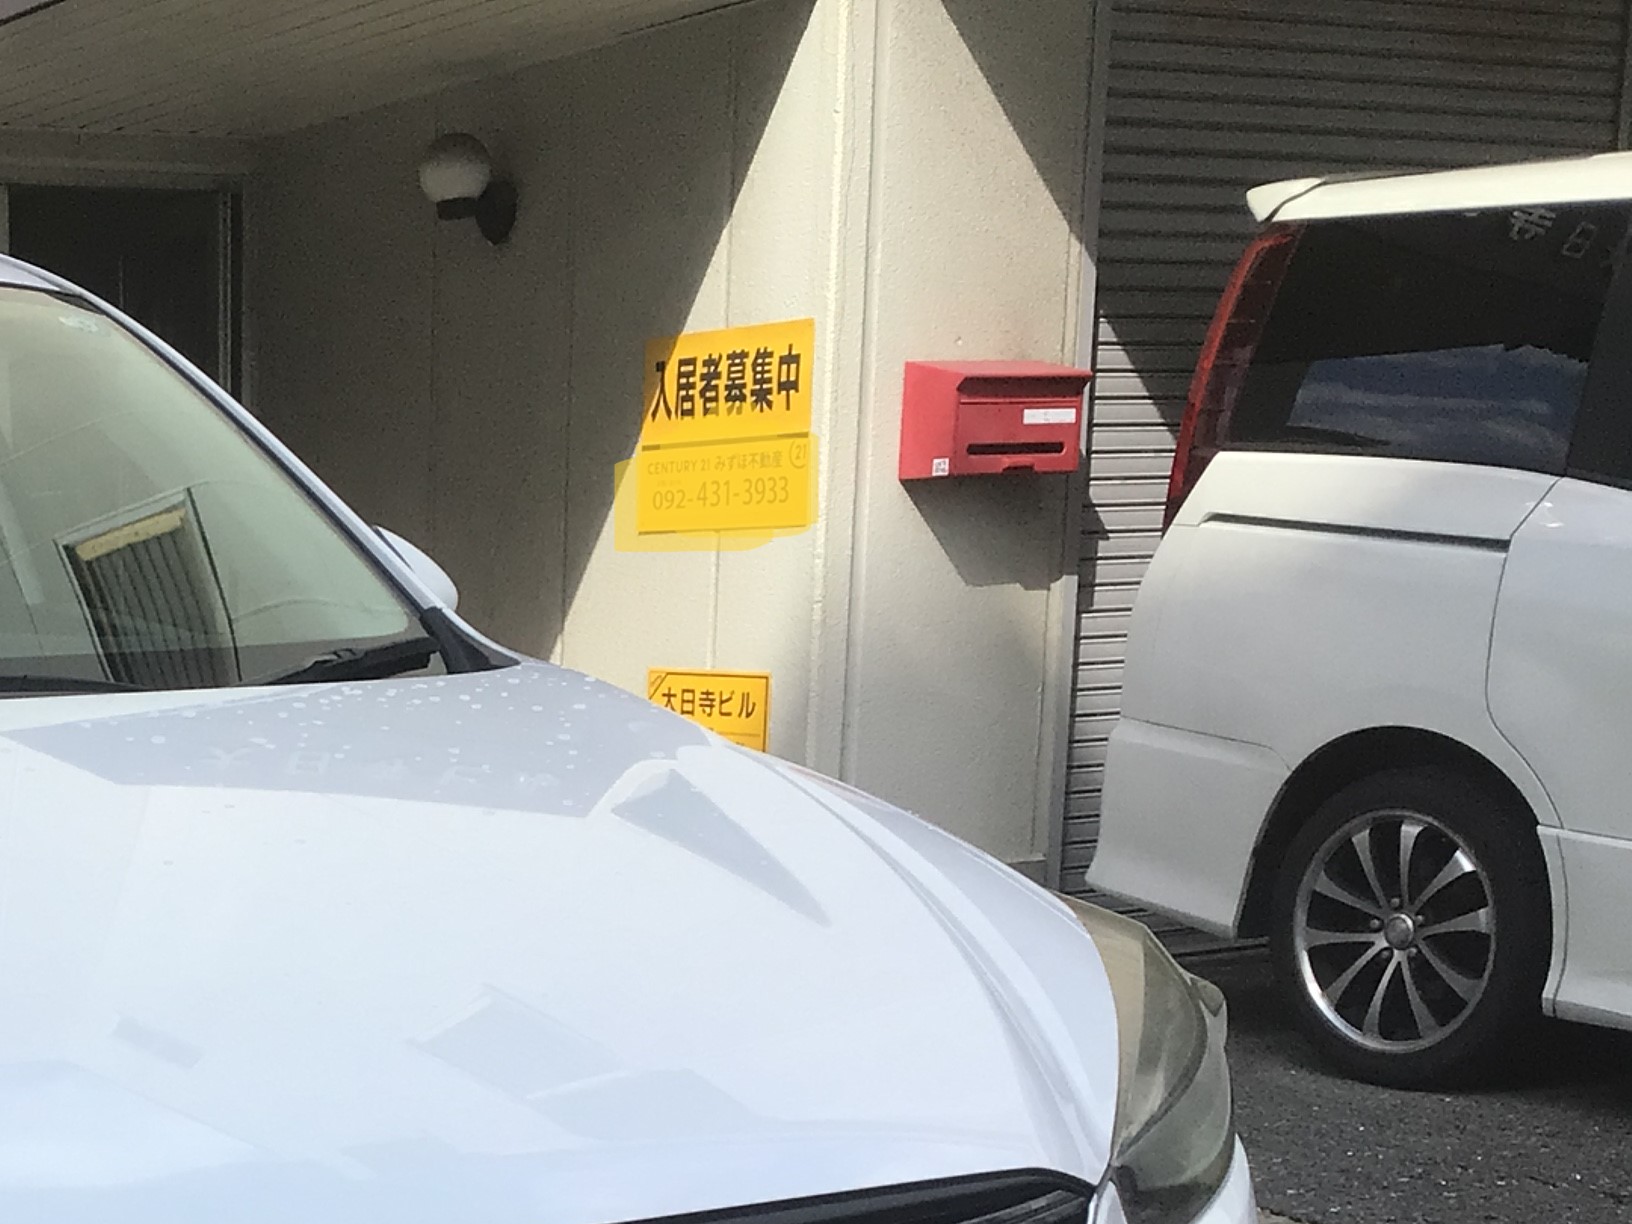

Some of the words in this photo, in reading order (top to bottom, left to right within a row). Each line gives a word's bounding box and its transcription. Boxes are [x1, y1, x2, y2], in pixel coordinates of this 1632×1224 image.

[651, 344, 801, 422] 入居者募集中
[647, 459, 698, 475] CENTURY
[700, 457, 711, 472] 21
[714, 450, 783, 472] みずほ不動産
[652, 476, 789, 511] 092-431-3933
[661, 687, 756, 719] 大日寺ビル
